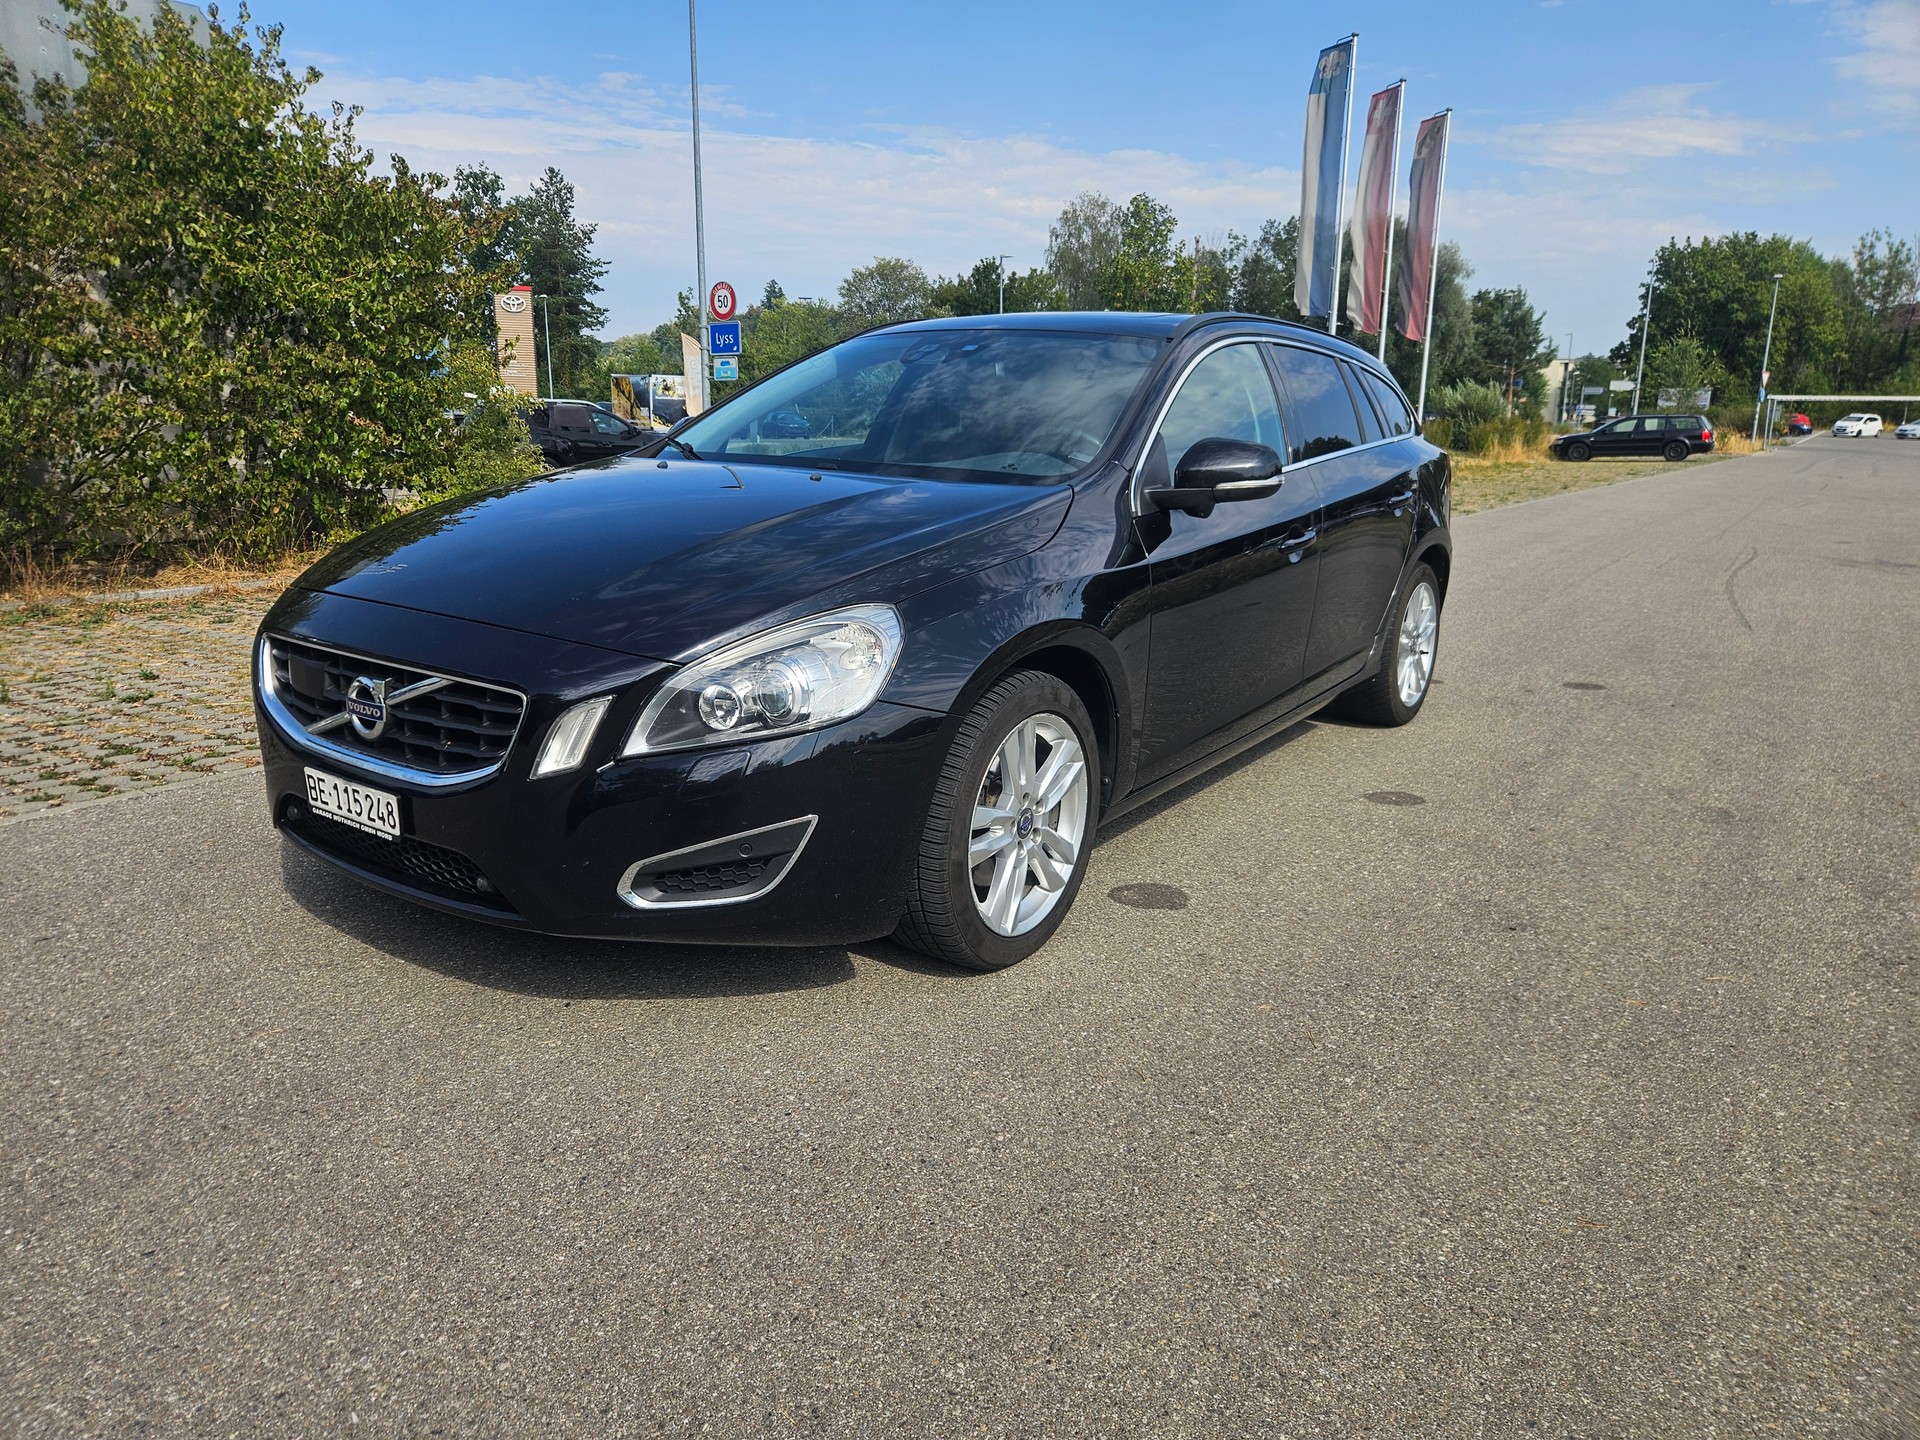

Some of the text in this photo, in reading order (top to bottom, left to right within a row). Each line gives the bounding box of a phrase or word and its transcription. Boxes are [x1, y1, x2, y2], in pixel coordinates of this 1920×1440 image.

[717, 295, 728, 308] 50
[715, 332, 734, 347] Lyss
[348, 701, 381, 717] VOLVO
[312, 807, 333, 819] GARAGE
